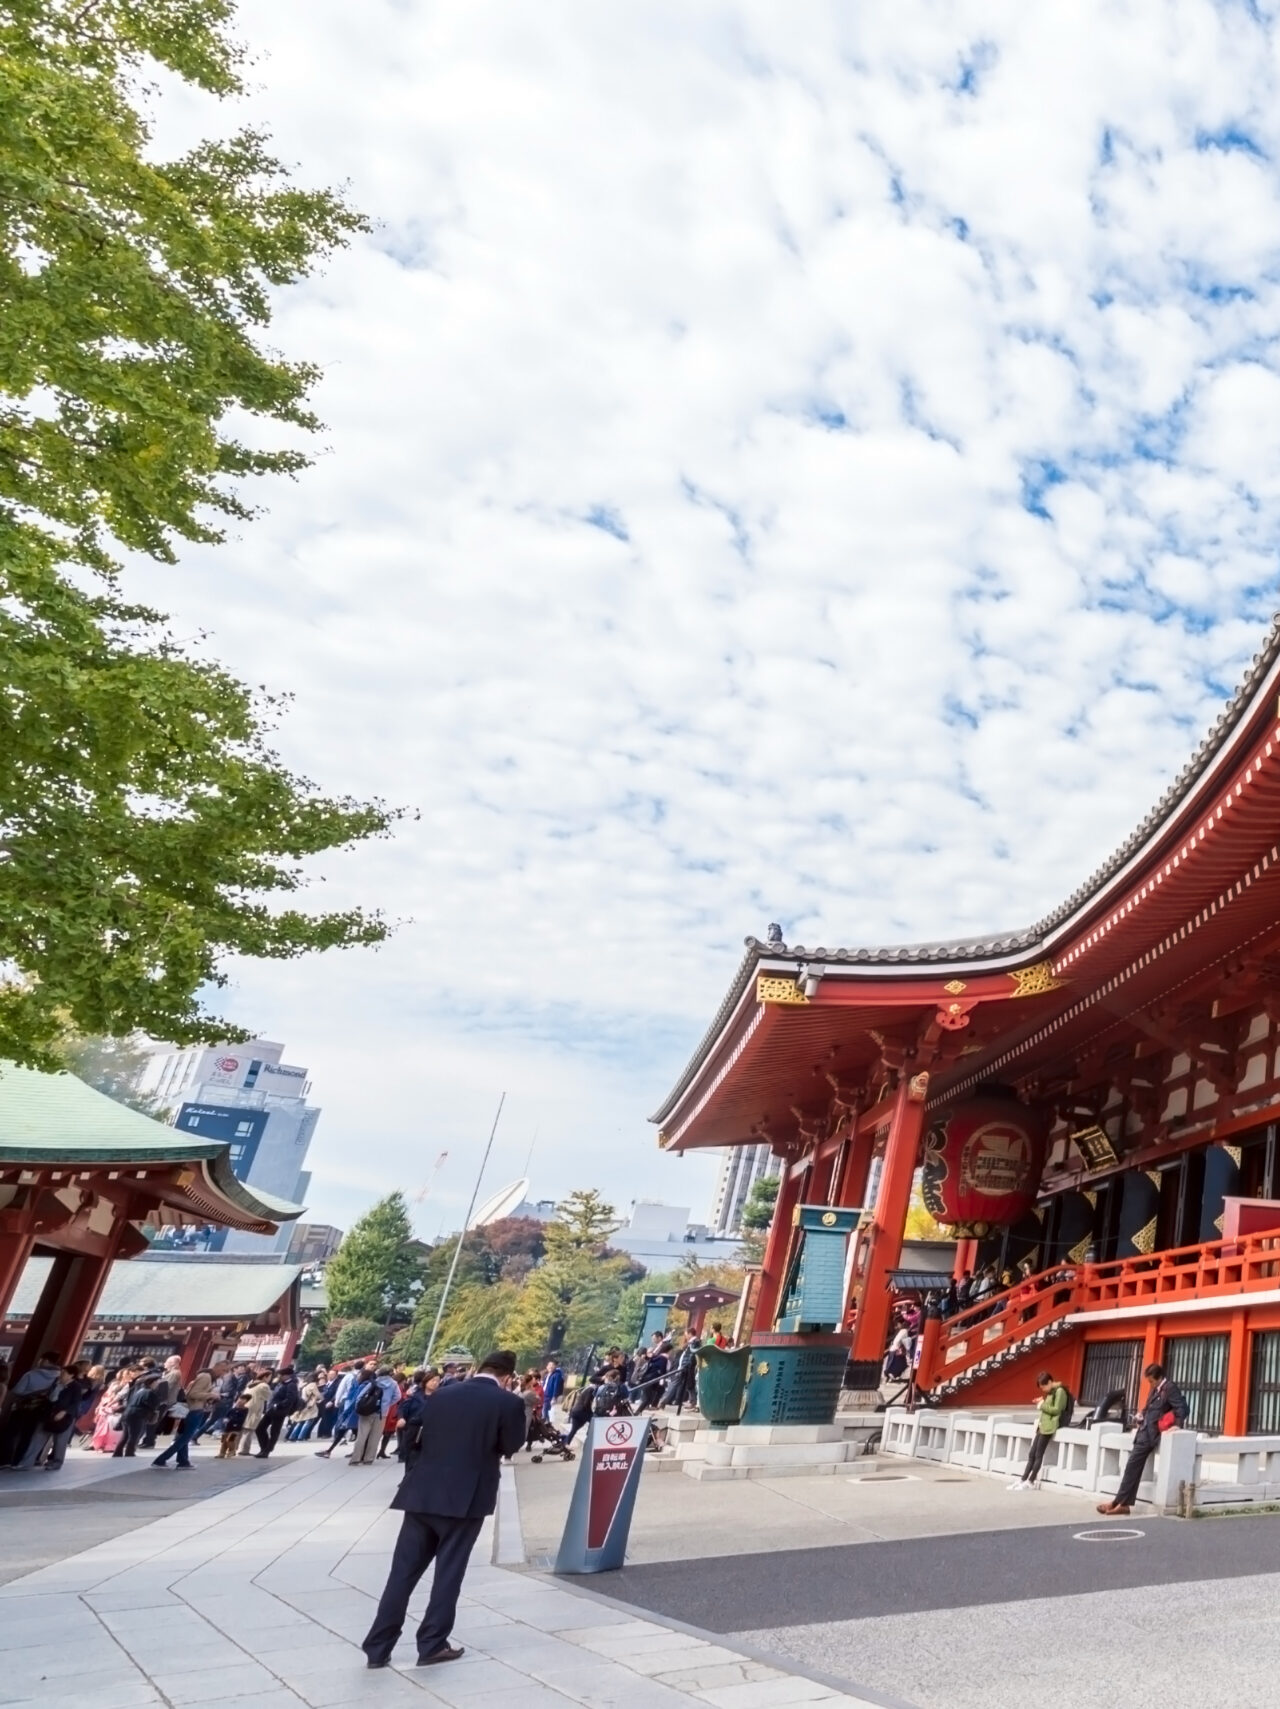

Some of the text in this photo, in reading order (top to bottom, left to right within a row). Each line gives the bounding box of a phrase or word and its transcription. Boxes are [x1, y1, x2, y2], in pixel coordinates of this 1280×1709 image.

[263, 1063, 306, 1079] Richmond
[602, 1453, 626, 1462] 自転車
[595, 1462, 628, 1471] 進入禁止
